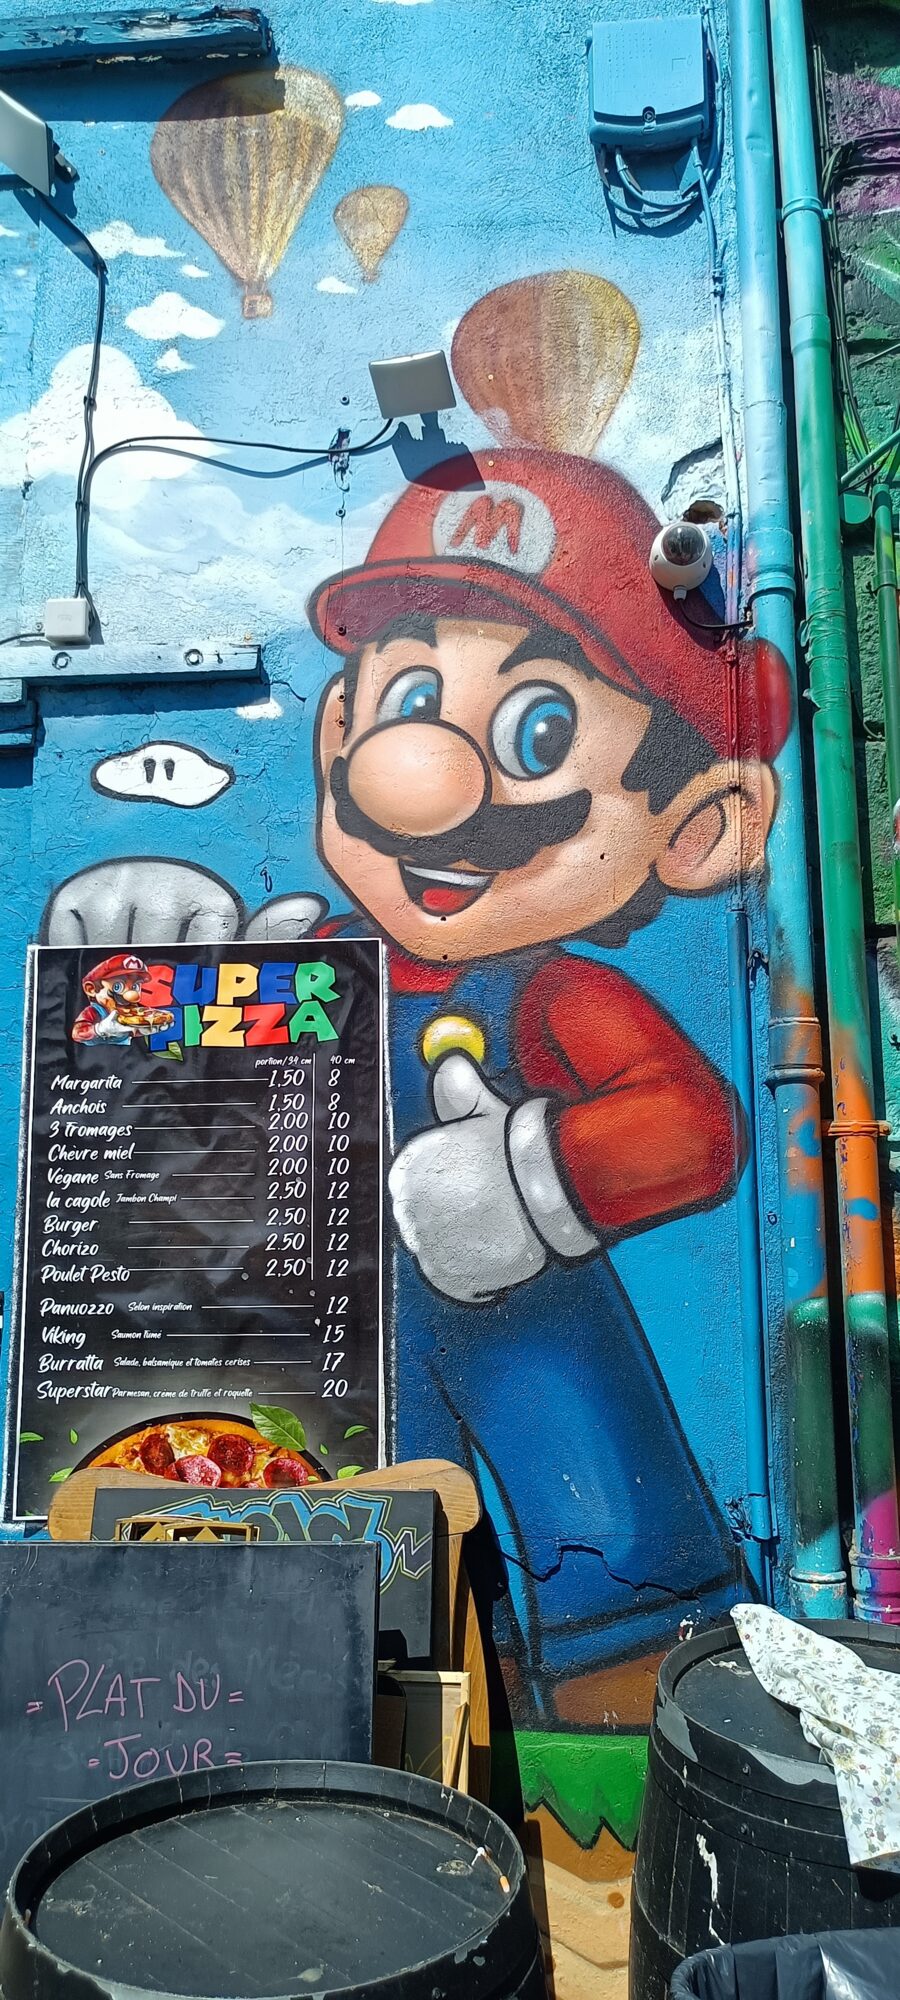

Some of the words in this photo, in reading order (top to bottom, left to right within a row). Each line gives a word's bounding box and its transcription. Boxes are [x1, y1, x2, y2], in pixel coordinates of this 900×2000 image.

[139, 961, 341, 1007] SUPER
[148, 1001, 339, 1051] PIZZA
[330, 1055, 342, 1065] 40
[51, 1075, 122, 1095] Margarita
[328, 1069, 340, 1087] 8
[50, 1098, 107, 1115] Anchois
[328, 1093, 340, 1111] 8
[49, 1121, 60, 1138] 3
[65, 1121, 133, 1142] Fromages
[328, 1112, 350, 1130] 10
[48, 1144, 98, 1161] Chèvre
[104, 1142, 135, 1160] miel
[328, 1135, 350, 1153] 10
[47, 1168, 99, 1189] Végane
[104, 1170, 123, 1180] Sans
[126, 1170, 160, 1182] Fromage
[328, 1158, 350, 1175] 10
[46, 1191, 59, 1208] la
[65, 1190, 111, 1213] cagole
[116, 1193, 146, 1203] Jambon
[148, 1193, 177, 1205] Champi
[327, 1181, 350, 1199] 12
[43, 1215, 98, 1237] Burger
[327, 1208, 350, 1226] 12
[41, 1239, 99, 1257] Chorizo
[327, 1233, 350, 1251] 12
[41, 1264, 88, 1284] Poulet
[90, 1264, 130, 1283] Pesto
[326, 1259, 349, 1277] 12
[40, 1298, 114, 1317] Panuozzo
[128, 1302, 150, 1312] Selon
[152, 1302, 192, 1313] inspiration
[326, 1296, 349, 1314] 12
[41, 1326, 86, 1349] Viking
[111, 1329, 141, 1339] Saumon
[323, 1325, 346, 1343] 15
[38, 1353, 103, 1373] Burratta
[113, 1357, 141, 1367] Salade,
[143, 1357, 183, 1369] balsamique
[186, 1358, 193, 1366] et
[194, 1358, 222, 1366] tomates
[225, 1358, 250, 1366] cerises
[322, 1352, 345, 1371] 17
[37, 1380, 112, 1404] Superstar
[112, 1387, 151, 1398] Parmesan,
[179, 1389, 188, 1397] de
[214, 1388, 222, 1397] et
[223, 1388, 253, 1399] roquette
[321, 1379, 348, 1398] 20
[47, 1658, 161, 1732] PLAT
[172, 1671, 221, 1713] DU
[103, 1733, 214, 1780] JOUR
